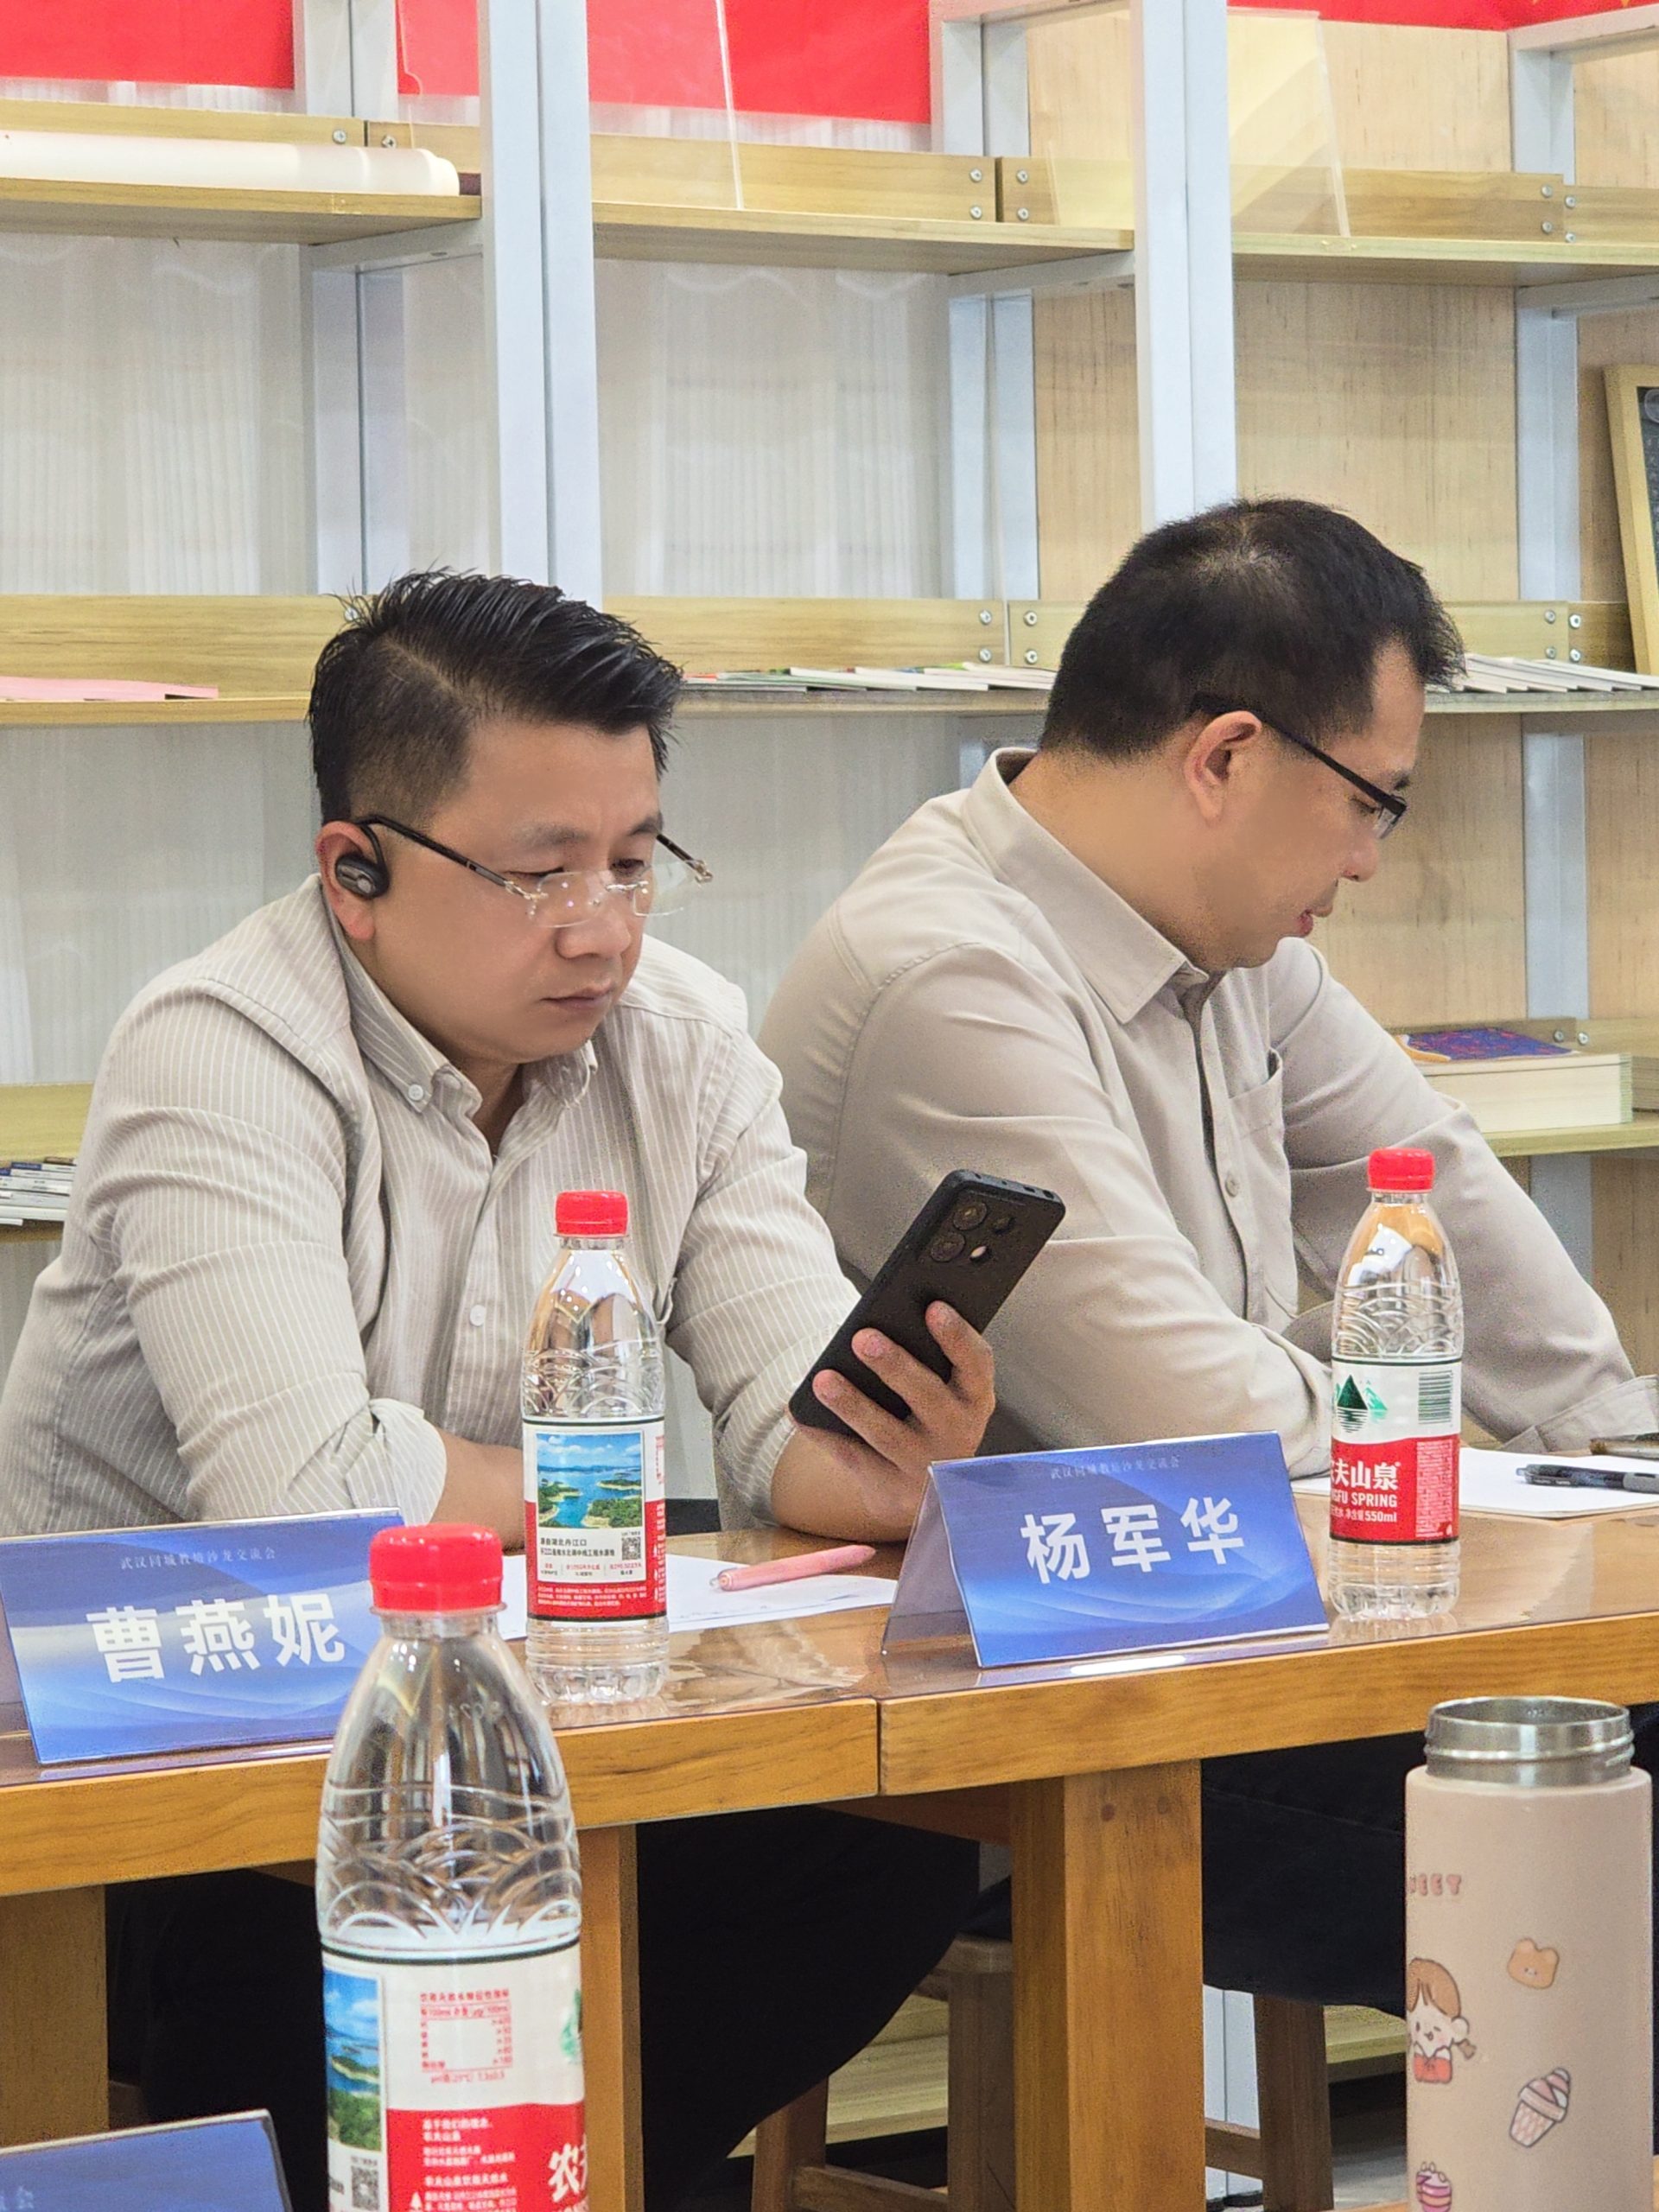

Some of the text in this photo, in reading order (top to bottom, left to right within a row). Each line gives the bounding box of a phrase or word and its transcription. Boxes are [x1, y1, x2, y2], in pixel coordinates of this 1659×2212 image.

[1020, 1496, 1245, 1584] 杨军华
[1351, 1491, 1397, 1508] SPRING
[86, 1592, 346, 1683] 曹燕妮
